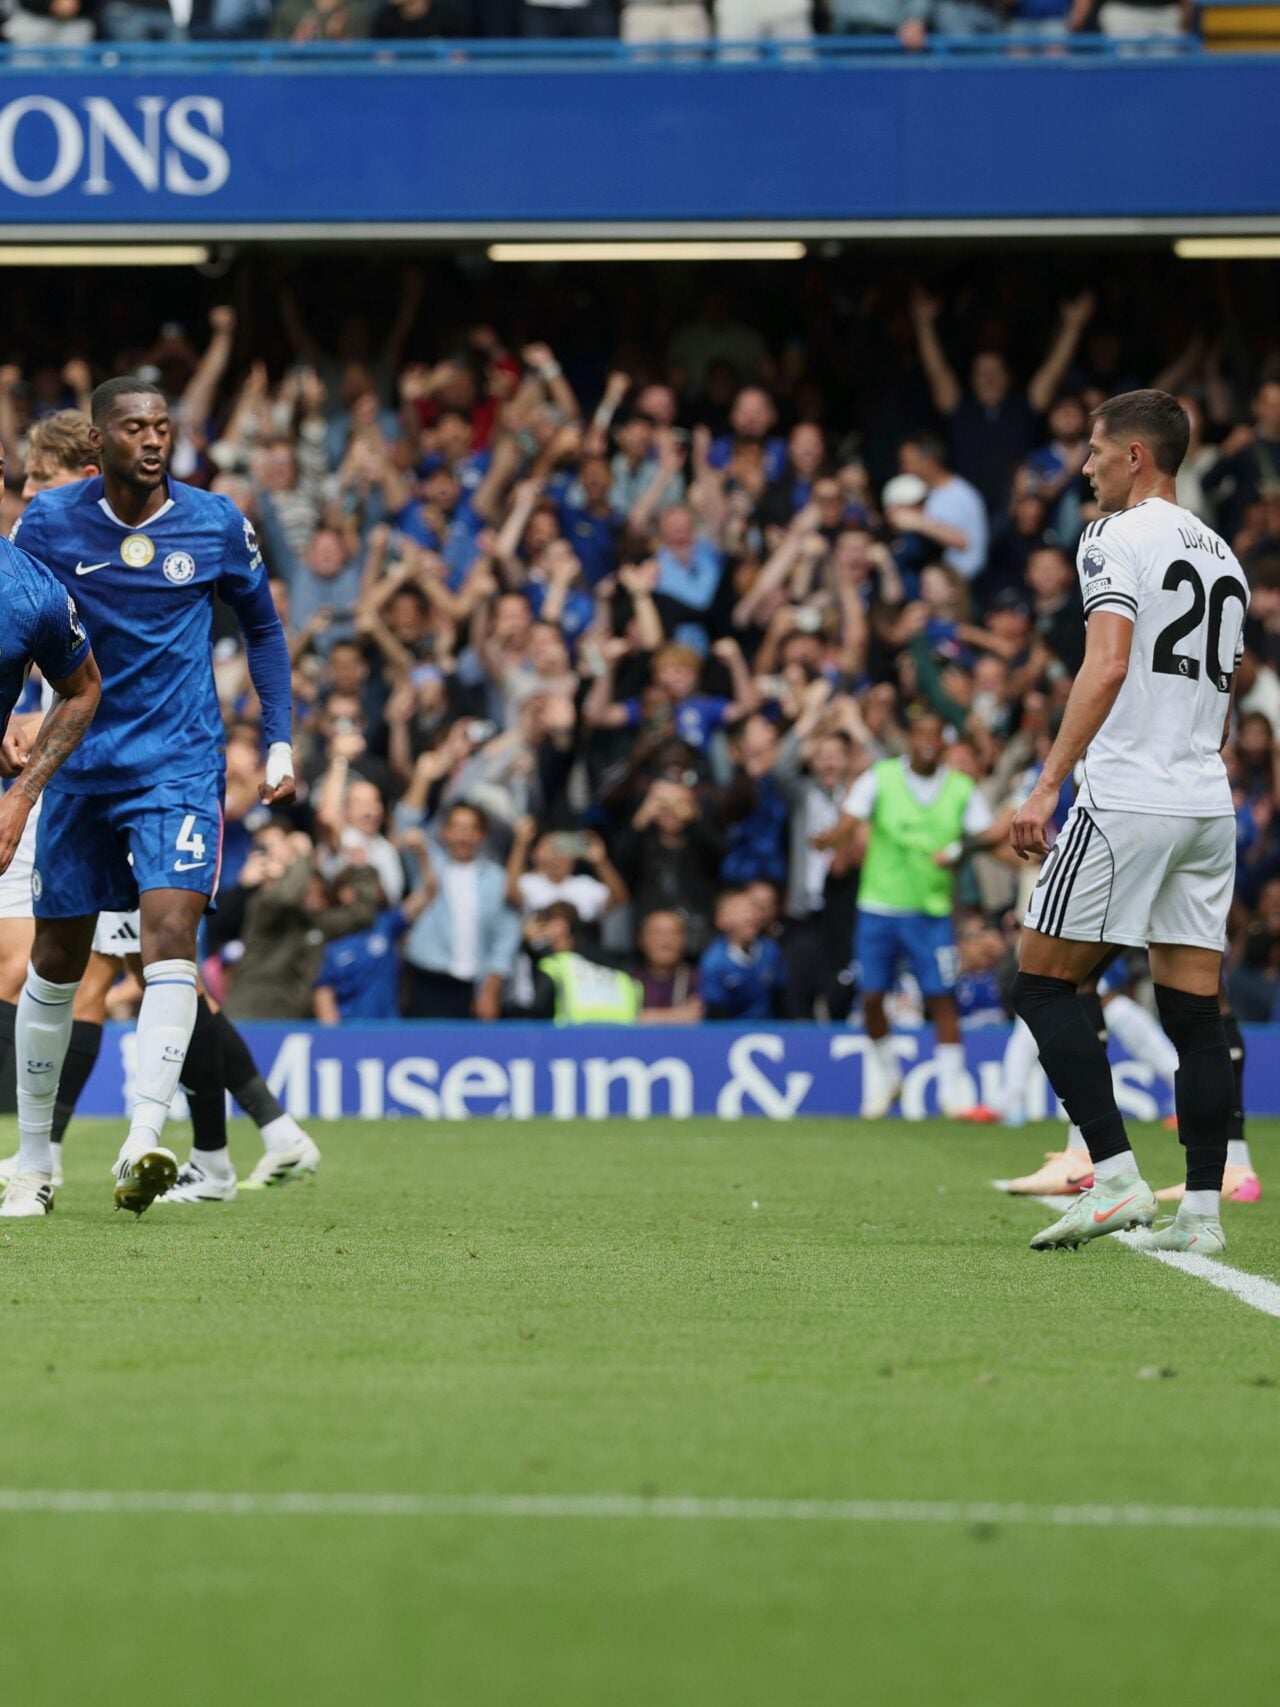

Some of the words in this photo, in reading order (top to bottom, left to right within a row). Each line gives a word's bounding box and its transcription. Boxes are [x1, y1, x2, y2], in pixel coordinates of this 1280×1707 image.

[1152, 559, 1247, 693] 20
[175, 814, 206, 860] 4
[717, 1034, 813, 1121] &
